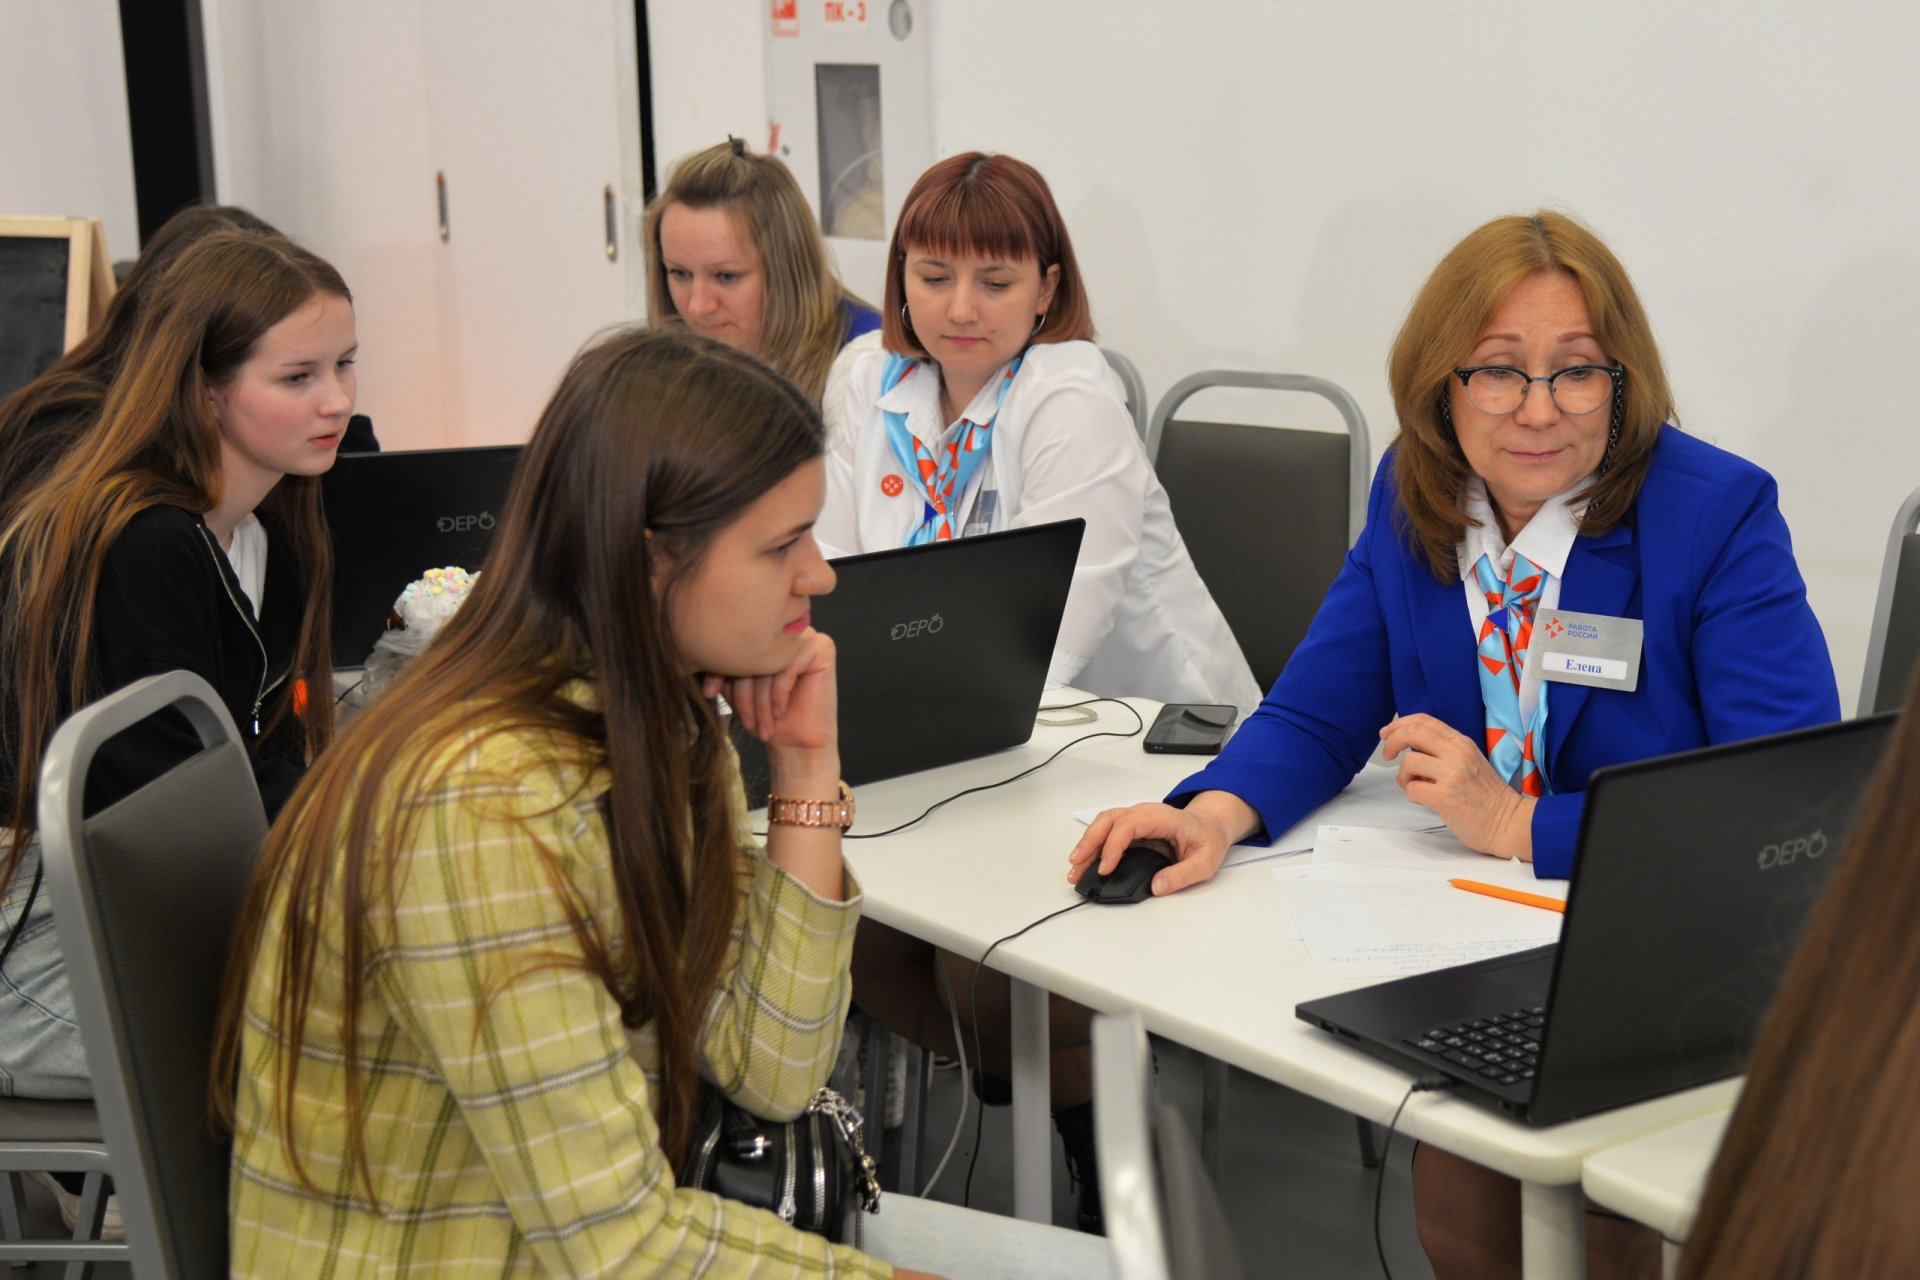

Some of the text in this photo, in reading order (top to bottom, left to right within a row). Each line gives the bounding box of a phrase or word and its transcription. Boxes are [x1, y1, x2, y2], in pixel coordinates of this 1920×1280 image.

[825, 1, 845, 22] ПК
[857, 1, 866, 22] 3
[437, 511, 496, 532] DEPO
[890, 613, 944, 640] DEPO
[1567, 630, 1598, 640] РОССИИ
[1568, 623, 1597, 632] РАБОТА
[1566, 658, 1602, 673] Елена
[1757, 829, 1827, 870] DEPO
